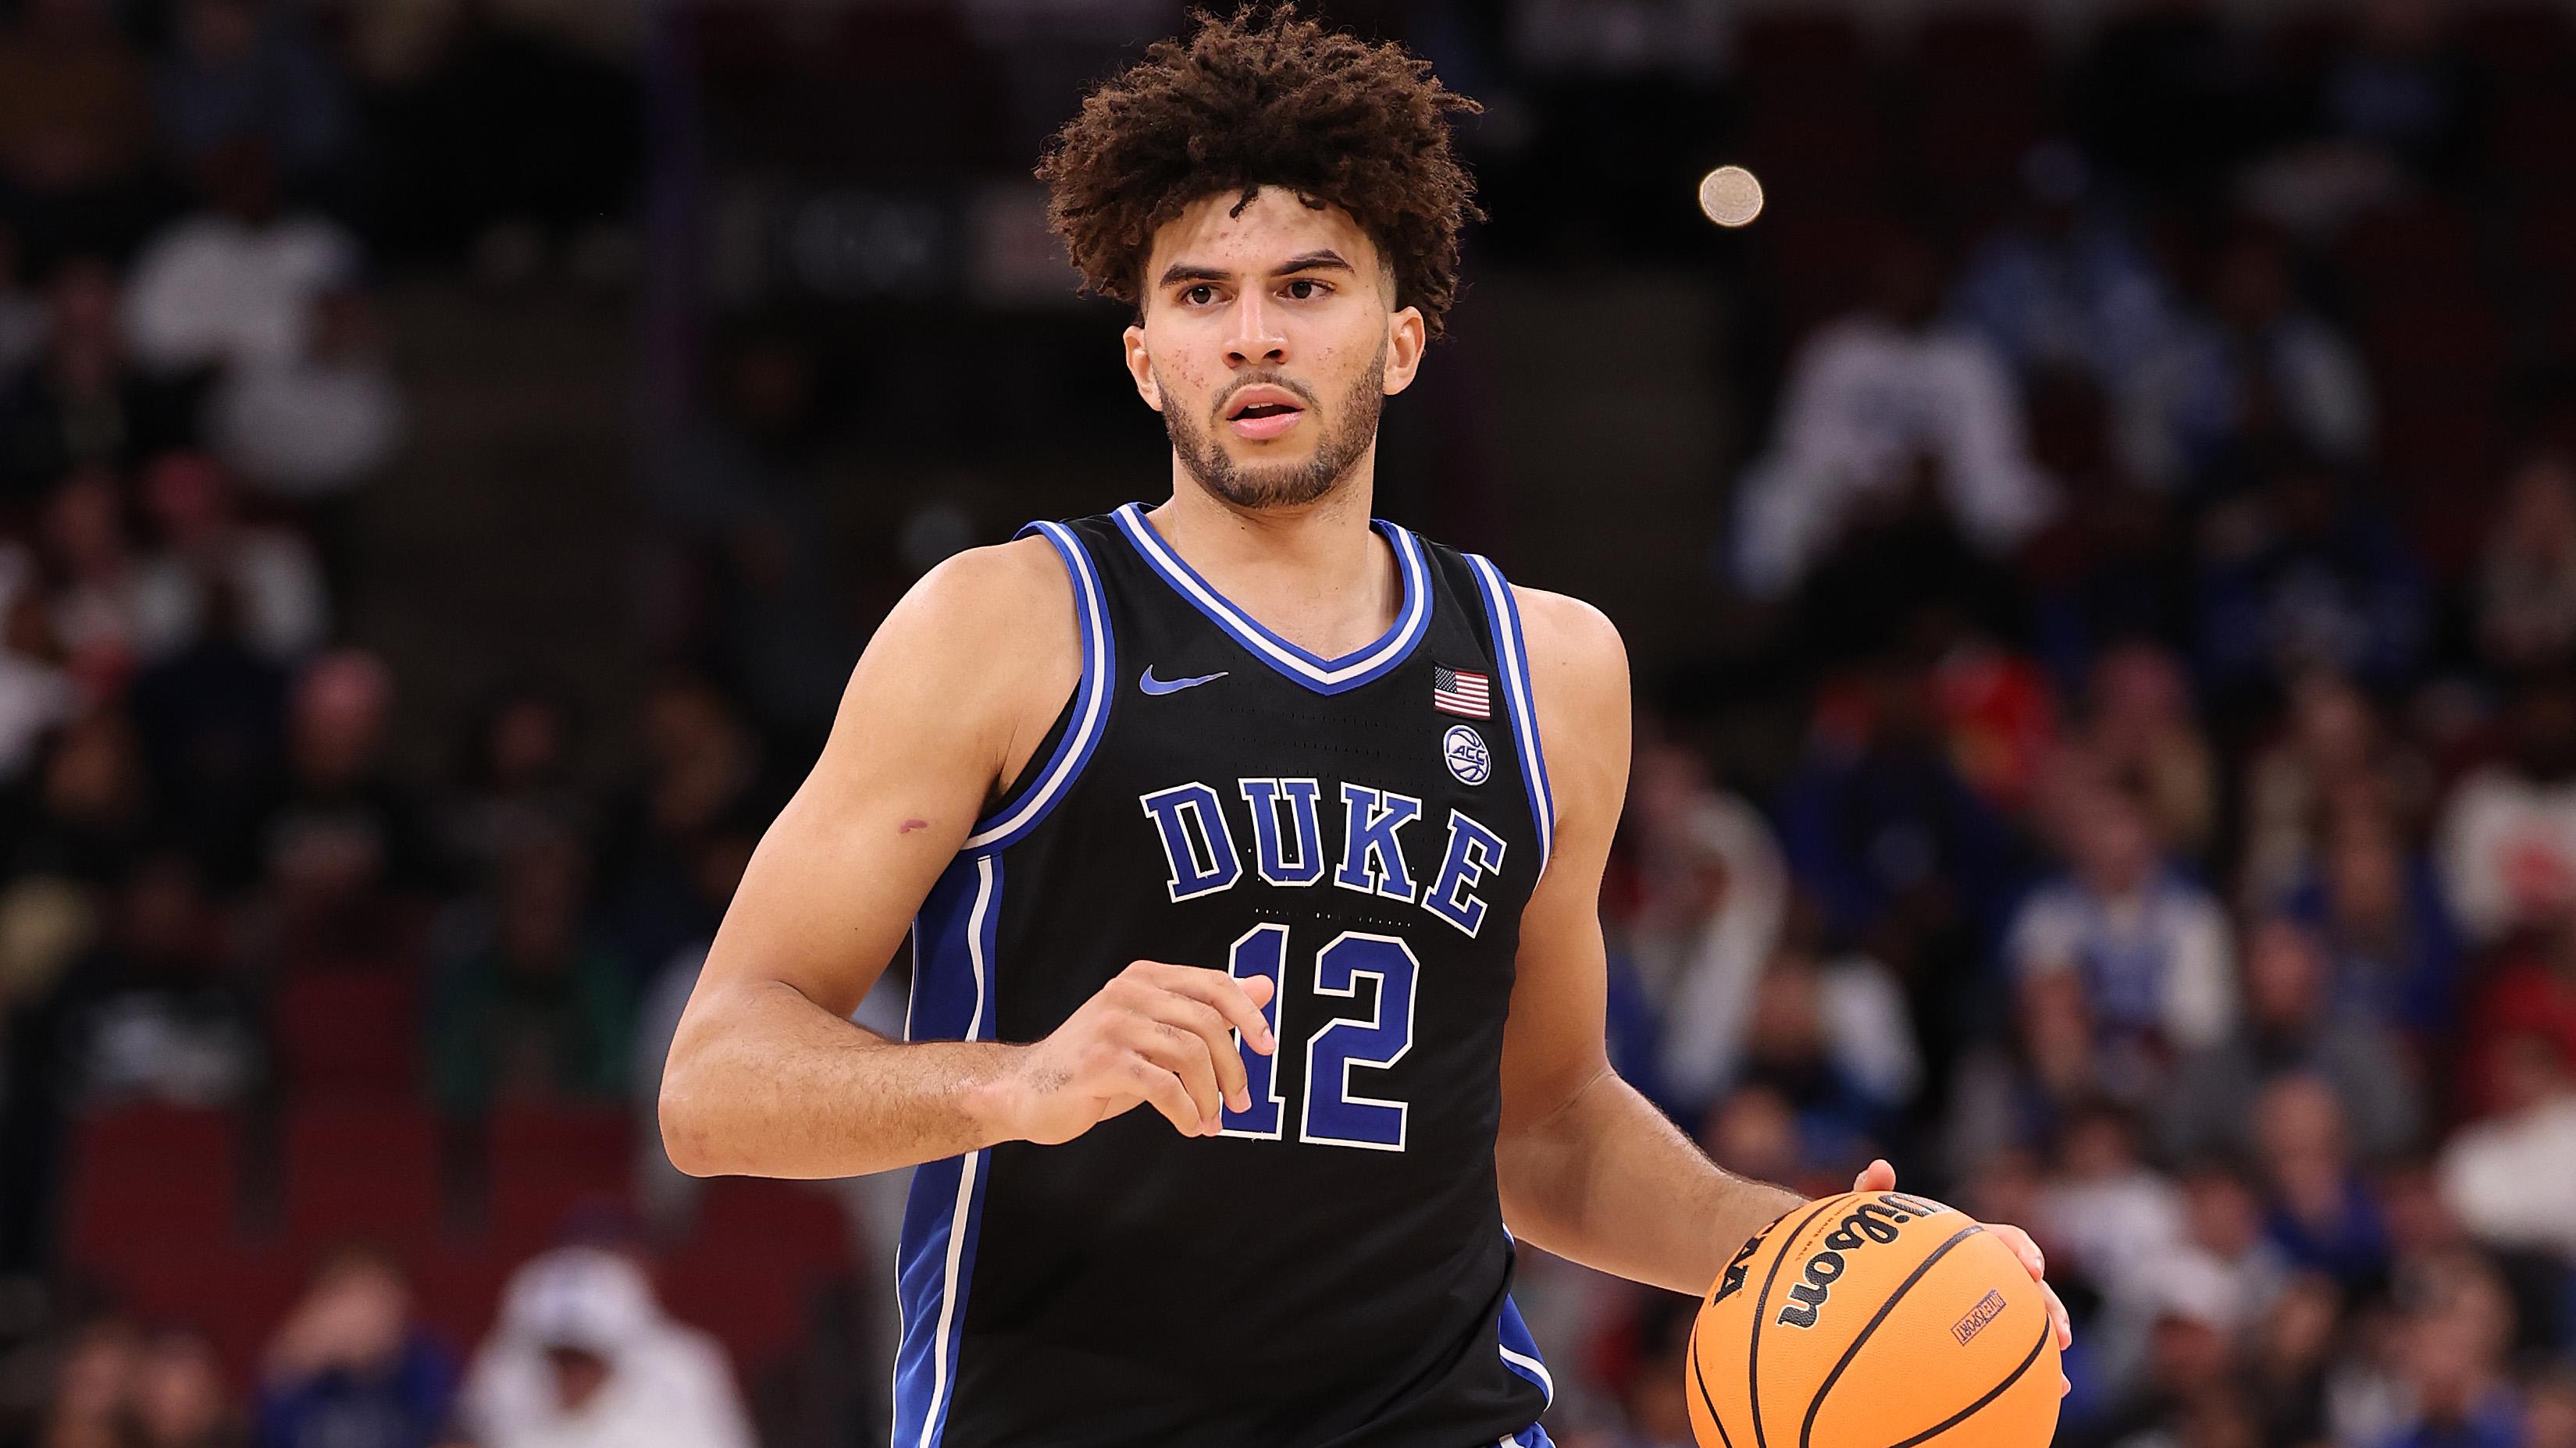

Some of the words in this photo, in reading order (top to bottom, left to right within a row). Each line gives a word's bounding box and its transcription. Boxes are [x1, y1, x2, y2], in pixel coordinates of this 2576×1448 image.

[1452, 744, 1487, 763] ACC
[1138, 777, 1508, 939] DUKE
[1217, 922, 1420, 1152] 12
